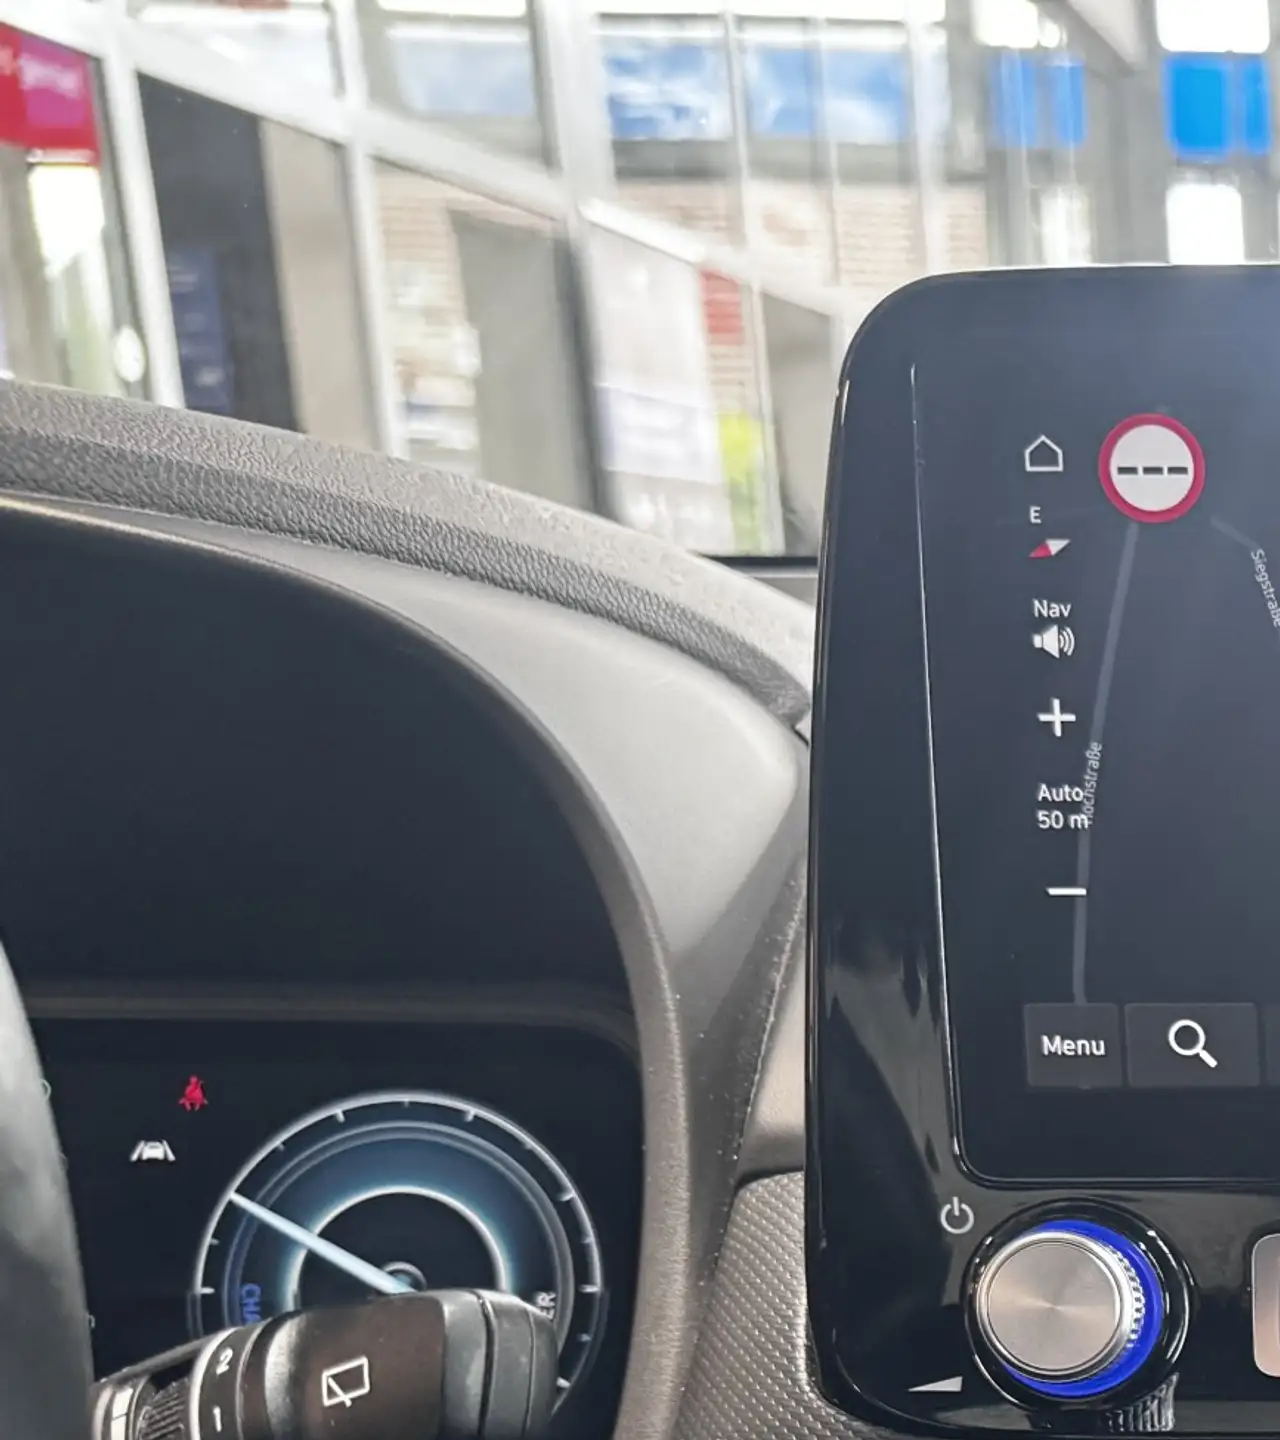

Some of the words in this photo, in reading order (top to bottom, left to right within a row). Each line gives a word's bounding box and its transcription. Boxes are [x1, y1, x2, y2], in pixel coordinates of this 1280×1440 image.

[1029, 506, 1042, 524] E
[1033, 600, 1072, 619] Nav
[1038, 783, 1084, 802] Auto
[1037, 810, 1064, 829] 50
[1068, 814, 1089, 829] m
[1041, 1035, 1106, 1057] Menu
[214, 1347, 234, 1376] 2
